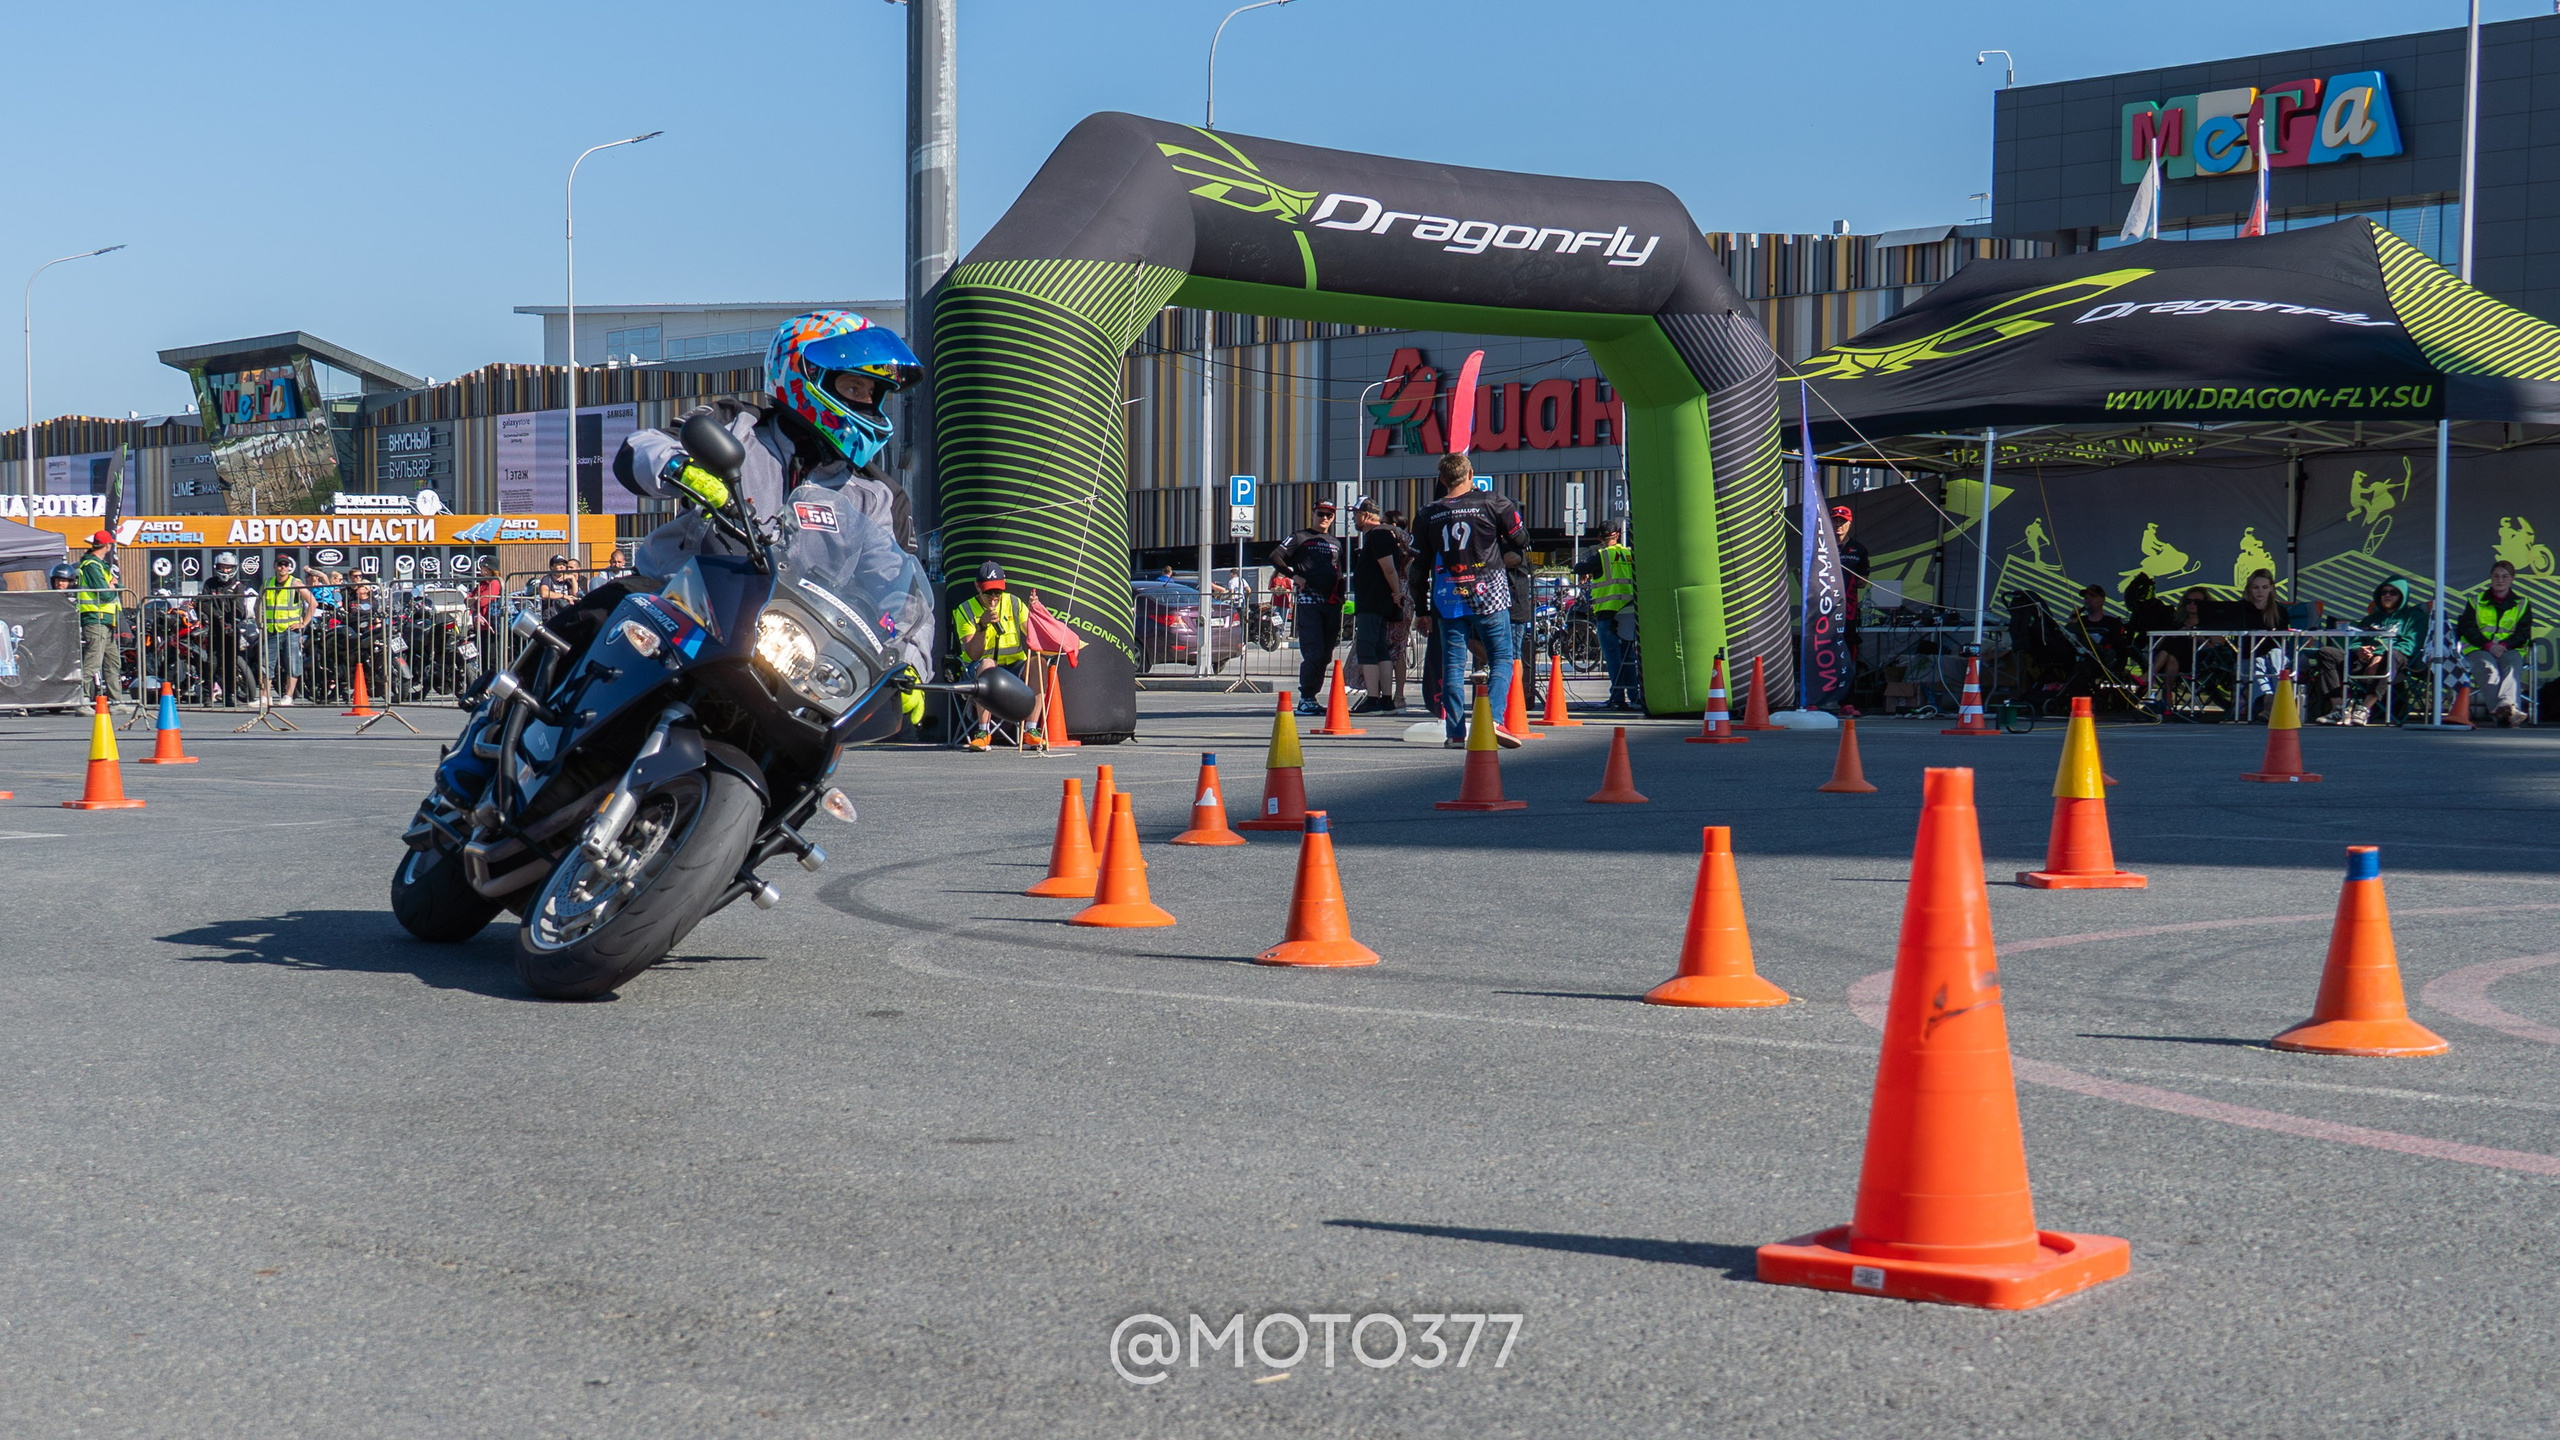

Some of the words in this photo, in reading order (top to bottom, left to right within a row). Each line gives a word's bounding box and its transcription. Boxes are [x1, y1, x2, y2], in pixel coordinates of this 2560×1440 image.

[2105, 385, 2433, 411] WWW.DRAGON-FLY.SU
[607, 409, 633, 418] SAMSUNG
[389, 426, 430, 452] ВКУСНЫЙ
[510, 470, 529, 480] этаж
[1615, 485, 1623, 497] Б
[1614, 500, 1624, 511] 10
[808, 510, 835, 526] 56
[141, 521, 184, 532] АВТО
[502, 519, 539, 529] АВТО
[227, 518, 435, 543] АВТОЗАПЧАСТИ
[500, 529, 567, 540] ЕВРОПЕЕЦ
[140, 532, 205, 543] ЯПОНЕЦ
[1441, 521, 1471, 552] 19
